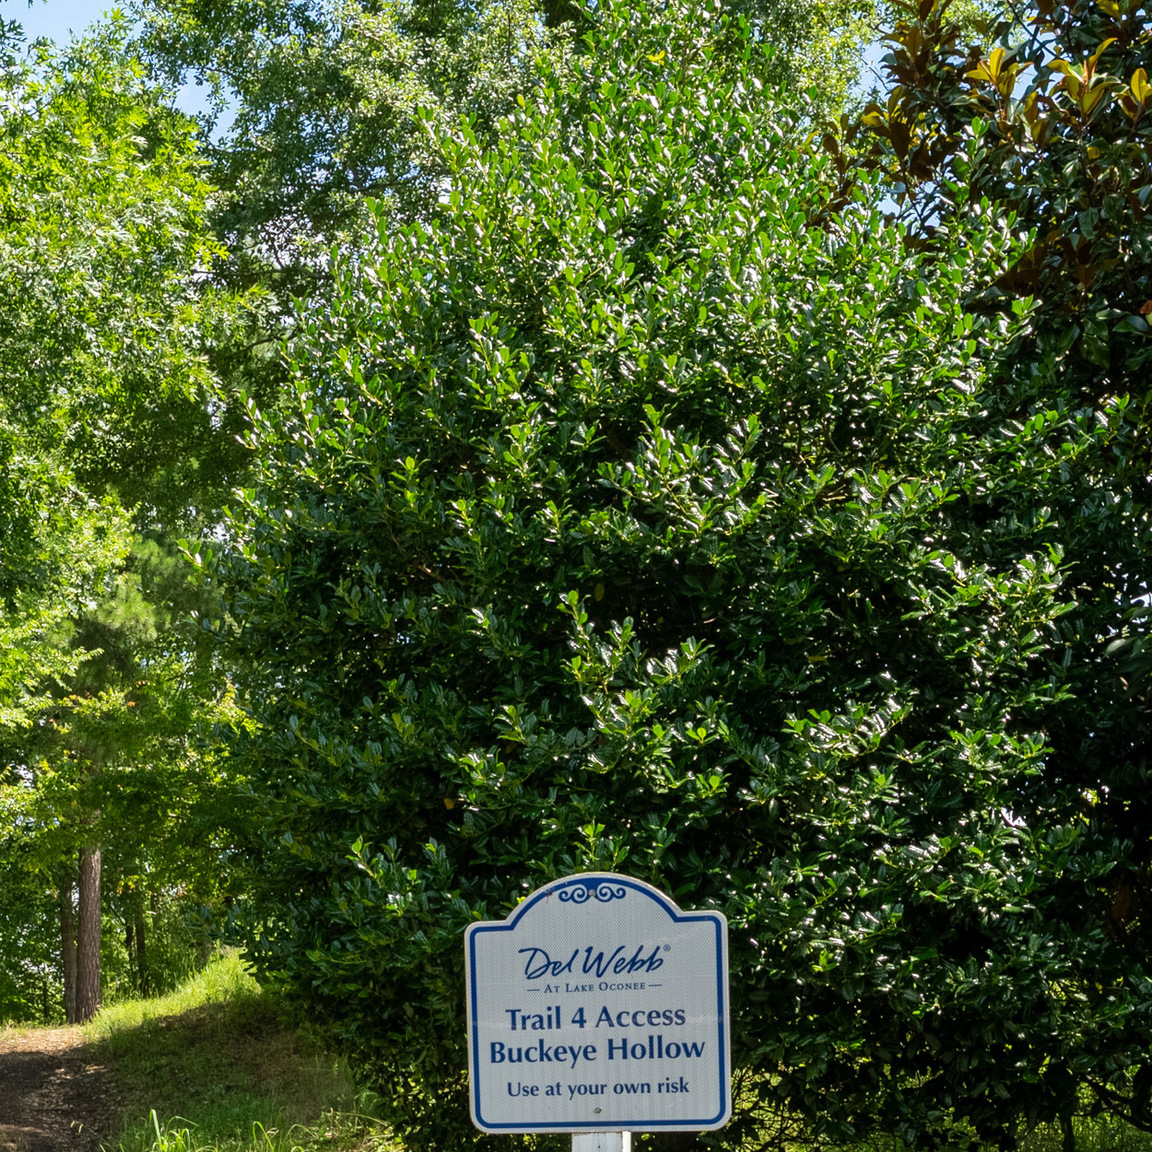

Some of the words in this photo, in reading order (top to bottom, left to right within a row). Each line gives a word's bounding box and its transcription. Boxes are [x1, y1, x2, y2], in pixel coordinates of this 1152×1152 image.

[518, 947, 579, 980] Del
[565, 983, 594, 993] LAKE
[598, 982, 646, 991] OCONEE
[505, 1006, 561, 1031] Trail
[571, 1007, 587, 1029] 4
[595, 1006, 686, 1028] Access
[490, 1039, 597, 1069] Buckeye
[608, 1035, 706, 1060] Hollow
[507, 1081, 539, 1097] Use
[545, 1083, 562, 1096] at
[568, 1082, 607, 1100] your
[613, 1083, 650, 1095] own
[657, 1077, 689, 1094] risk
